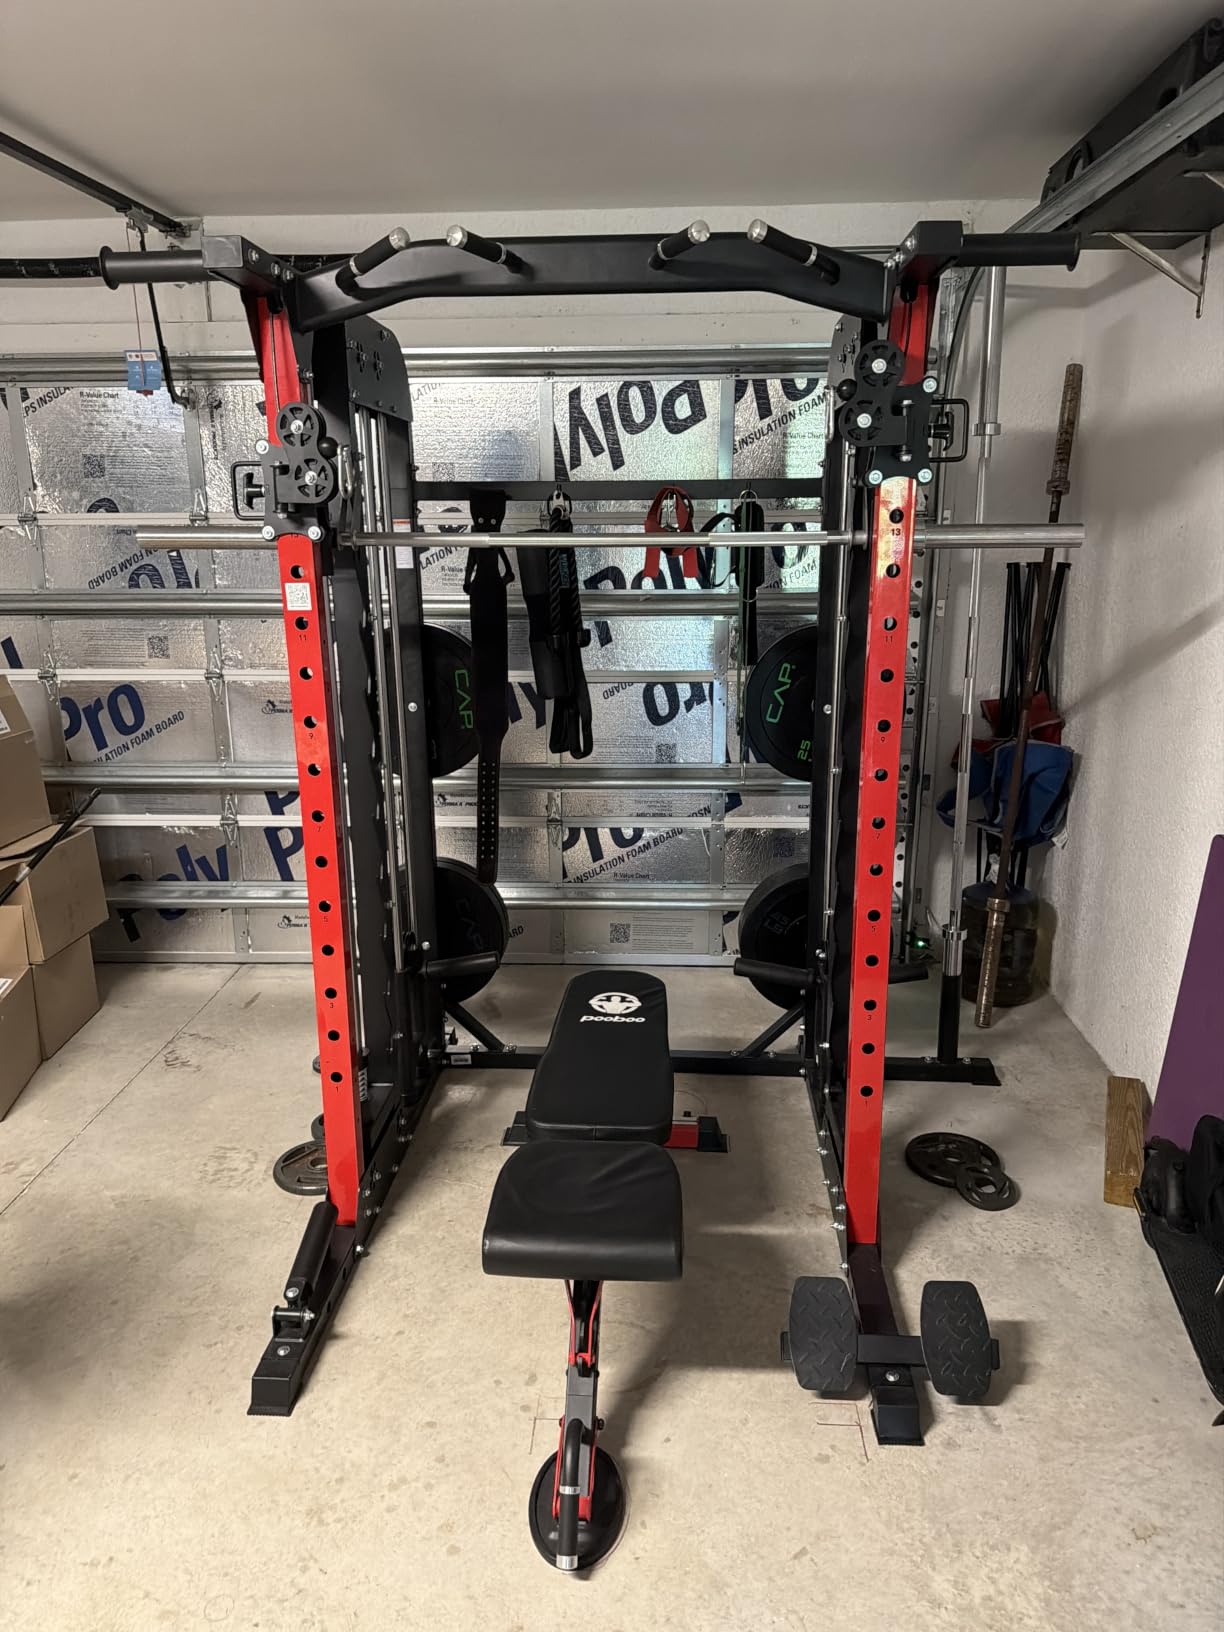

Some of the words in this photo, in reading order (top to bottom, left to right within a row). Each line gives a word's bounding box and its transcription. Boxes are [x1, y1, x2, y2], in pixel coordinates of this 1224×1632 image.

[79, 391, 103, 399] R-Value
[103, 391, 119, 399] Chart
[737, 409, 796, 450] INSULATION
[798, 392, 826, 416] FOAM
[891, 528, 901, 536] 13
[118, 553, 145, 573] FOAM
[88, 566, 118, 590] BOARD
[454, 669, 474, 729] CAP
[766, 663, 791, 724] CAP
[130, 726, 156, 751] FOAM
[155, 710, 185, 737] BOARD
[797, 739, 811, 761] 25
[573, 854, 625, 884] INSULATION
[626, 841, 652, 862] FOAM
[653, 828, 684, 847] BOARD
[633, 872, 650, 880] Chart
[579, 1014, 647, 1023] pooboo
